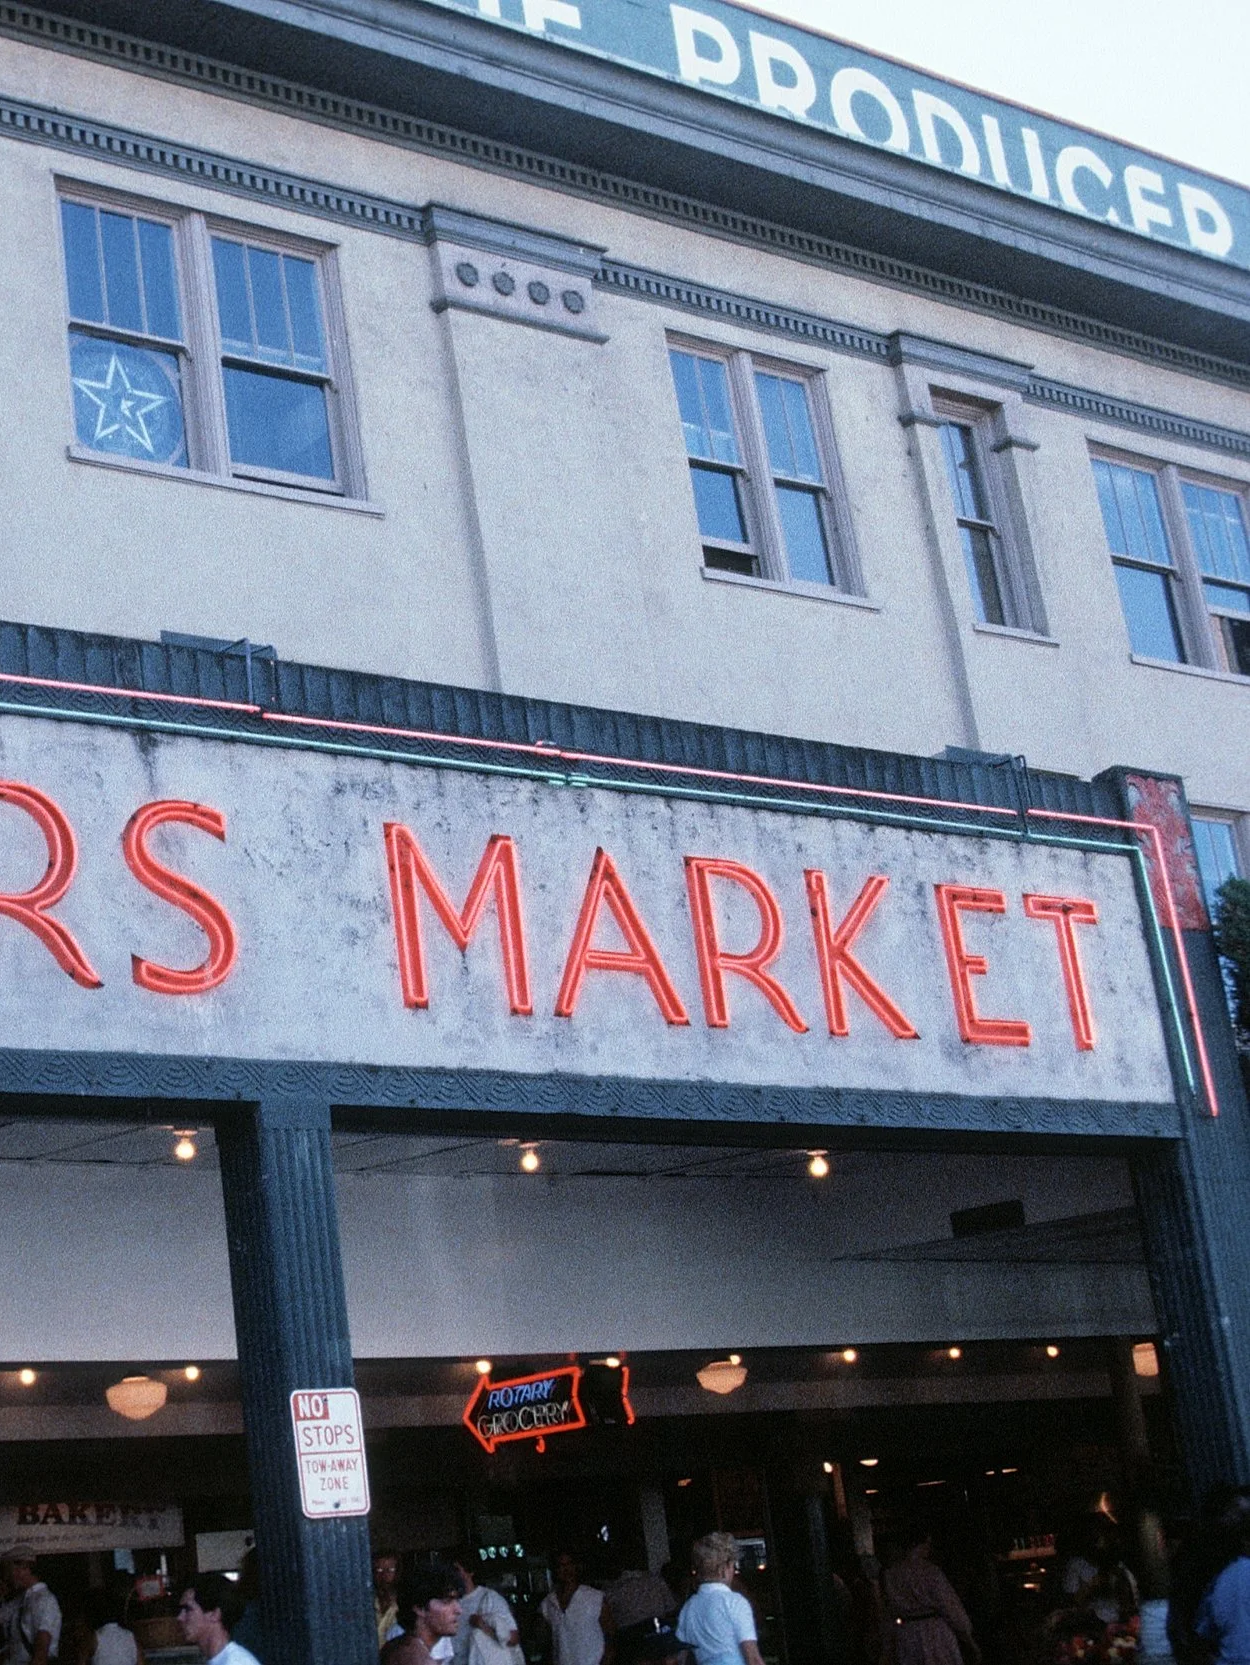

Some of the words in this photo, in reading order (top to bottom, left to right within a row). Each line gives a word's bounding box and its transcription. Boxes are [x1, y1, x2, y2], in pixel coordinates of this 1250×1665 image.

[383, 821, 1099, 1051] MARKET
[299, 1395, 324, 1418] NO
[488, 1379, 555, 1409] ROTARY
[477, 1401, 569, 1438] GROCERY
[303, 1425, 354, 1447] STOPS
[305, 1458, 358, 1474] TOW-AWAY
[320, 1476, 349, 1491] ZONE
[15, 1500, 172, 1528] BAKERY
